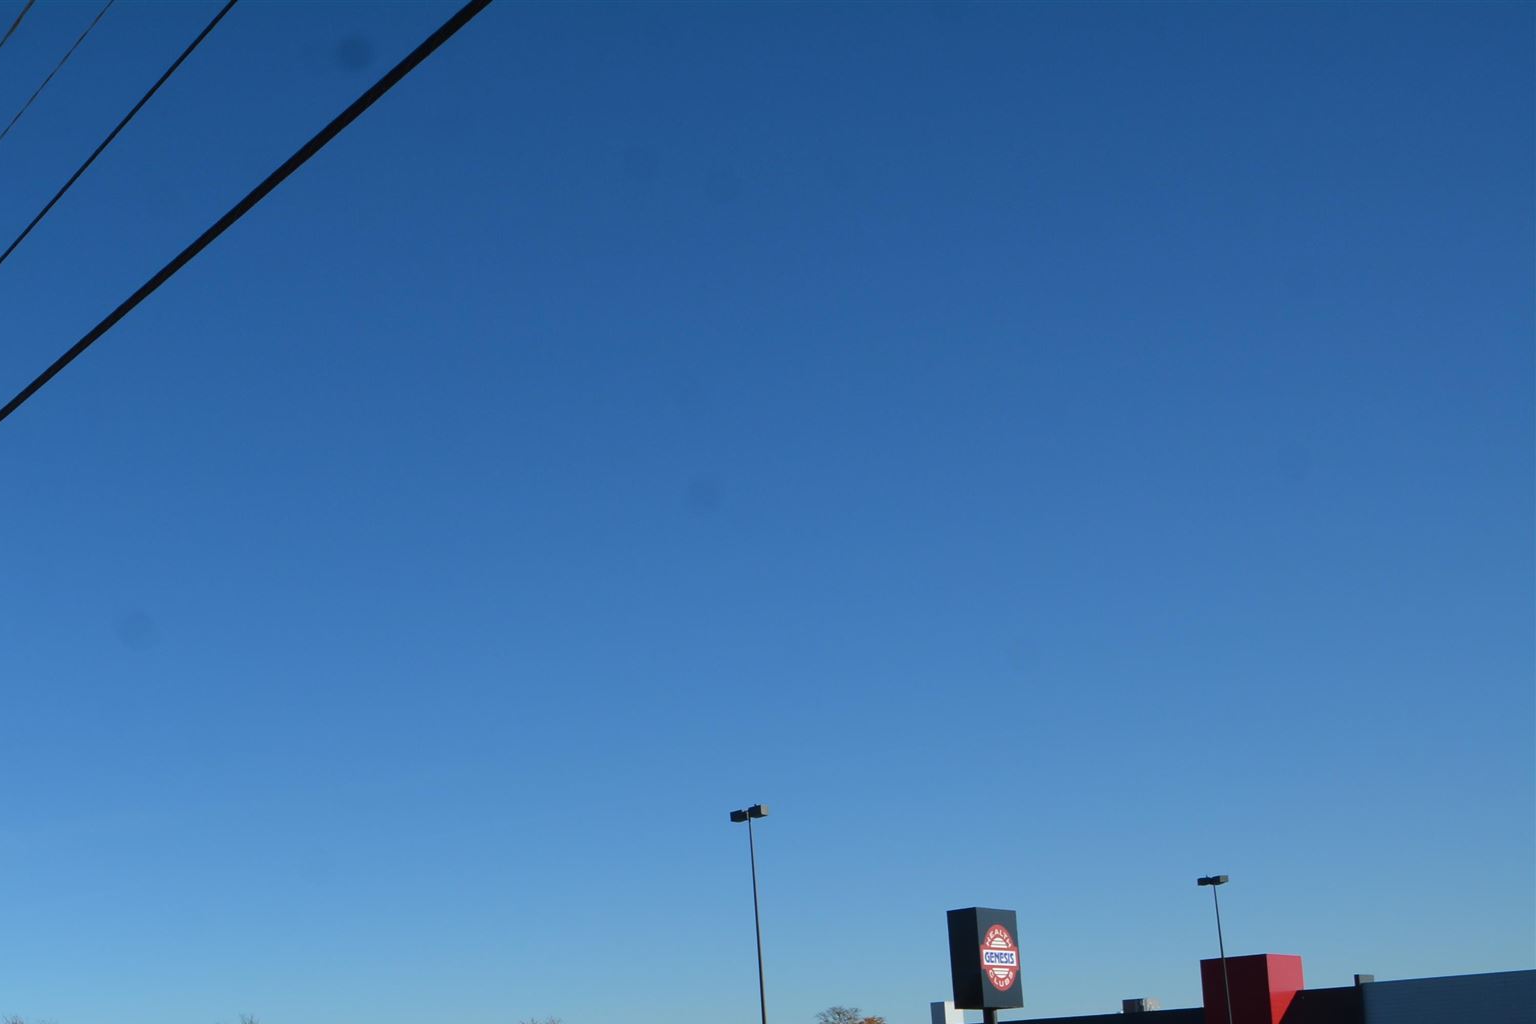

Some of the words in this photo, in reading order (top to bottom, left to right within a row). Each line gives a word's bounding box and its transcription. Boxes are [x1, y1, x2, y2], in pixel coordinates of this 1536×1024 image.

[985, 928, 1012, 948] HEALTH
[985, 952, 1015, 964] GENESIS
[989, 969, 1014, 987] CLUBS
